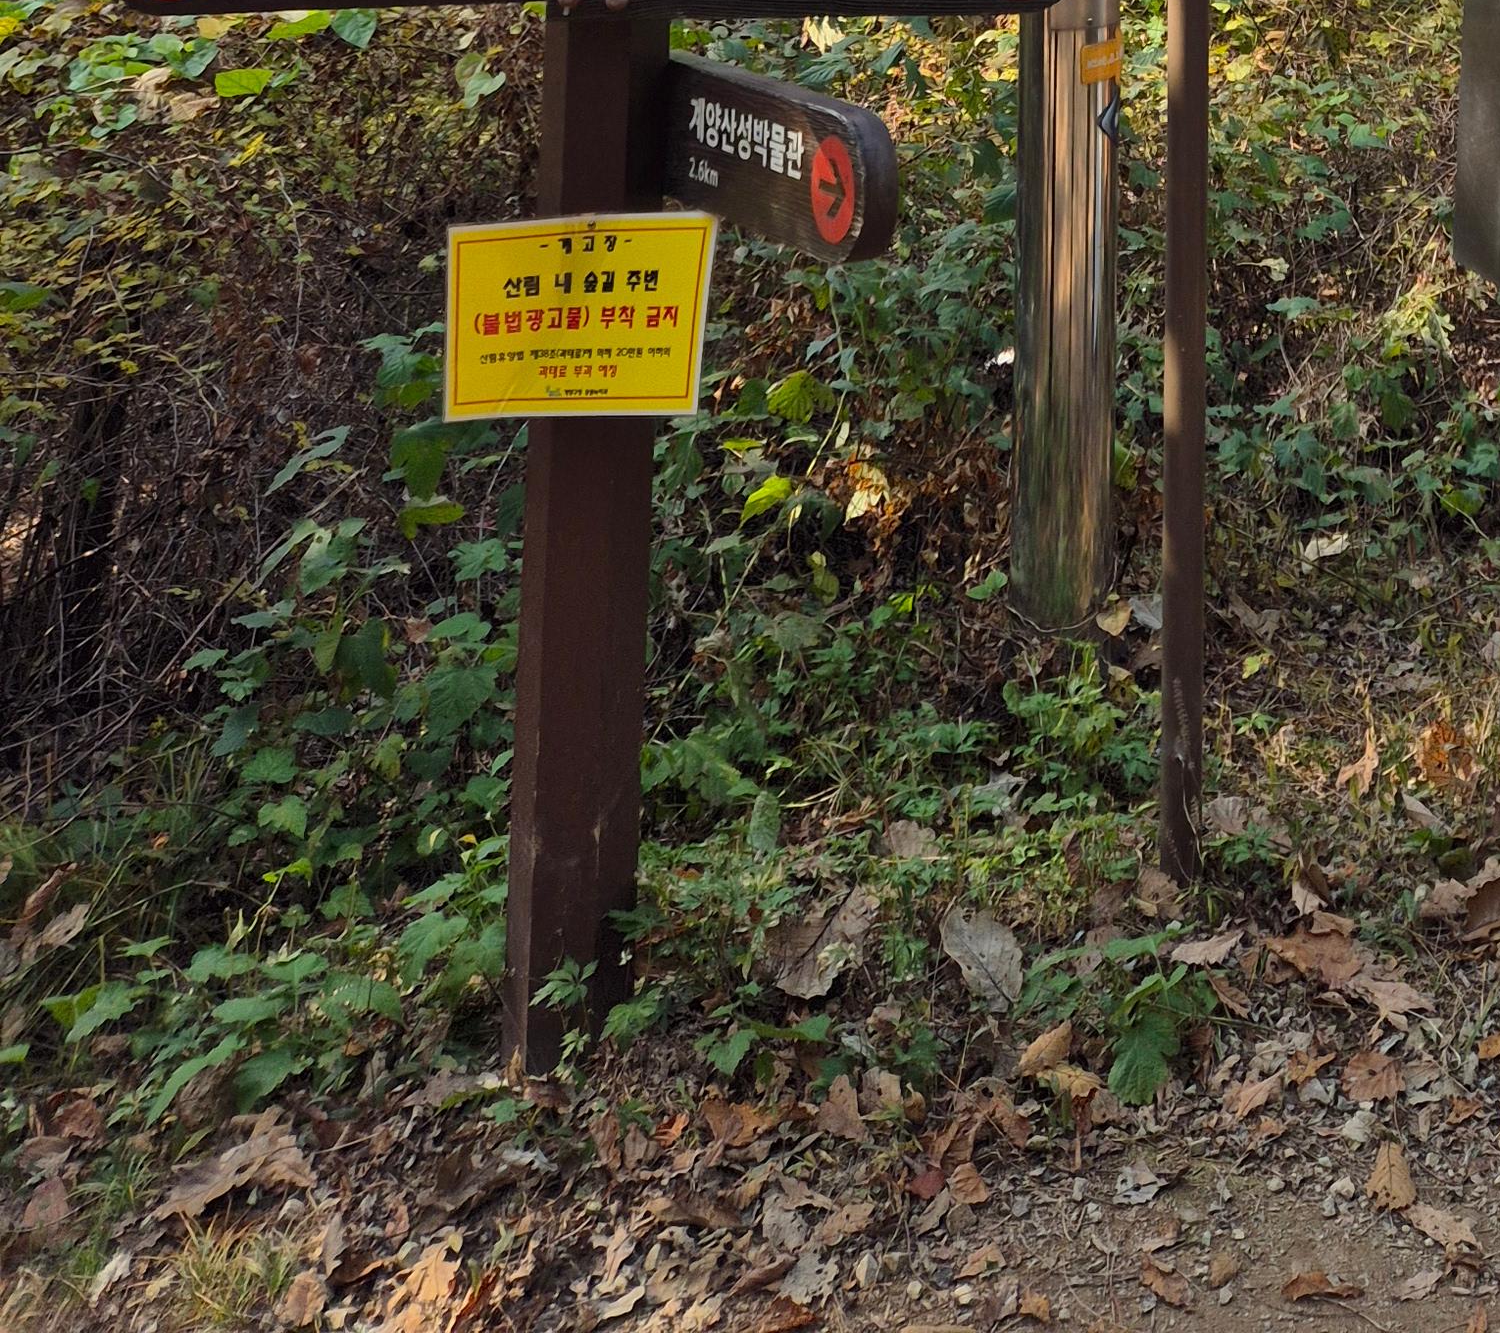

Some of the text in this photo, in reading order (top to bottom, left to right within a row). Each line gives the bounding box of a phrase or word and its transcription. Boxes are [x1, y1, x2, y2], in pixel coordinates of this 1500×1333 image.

[689, 97, 805, 180] 계양산성박물관
[688, 157, 719, 188] 2.6km
[503, 270, 659, 299] 산림 내 숲길 주변
[474, 305, 679, 336] (불법광고물) 부착 금지
[538, 364, 618, 379] 과태료 부과 예정
